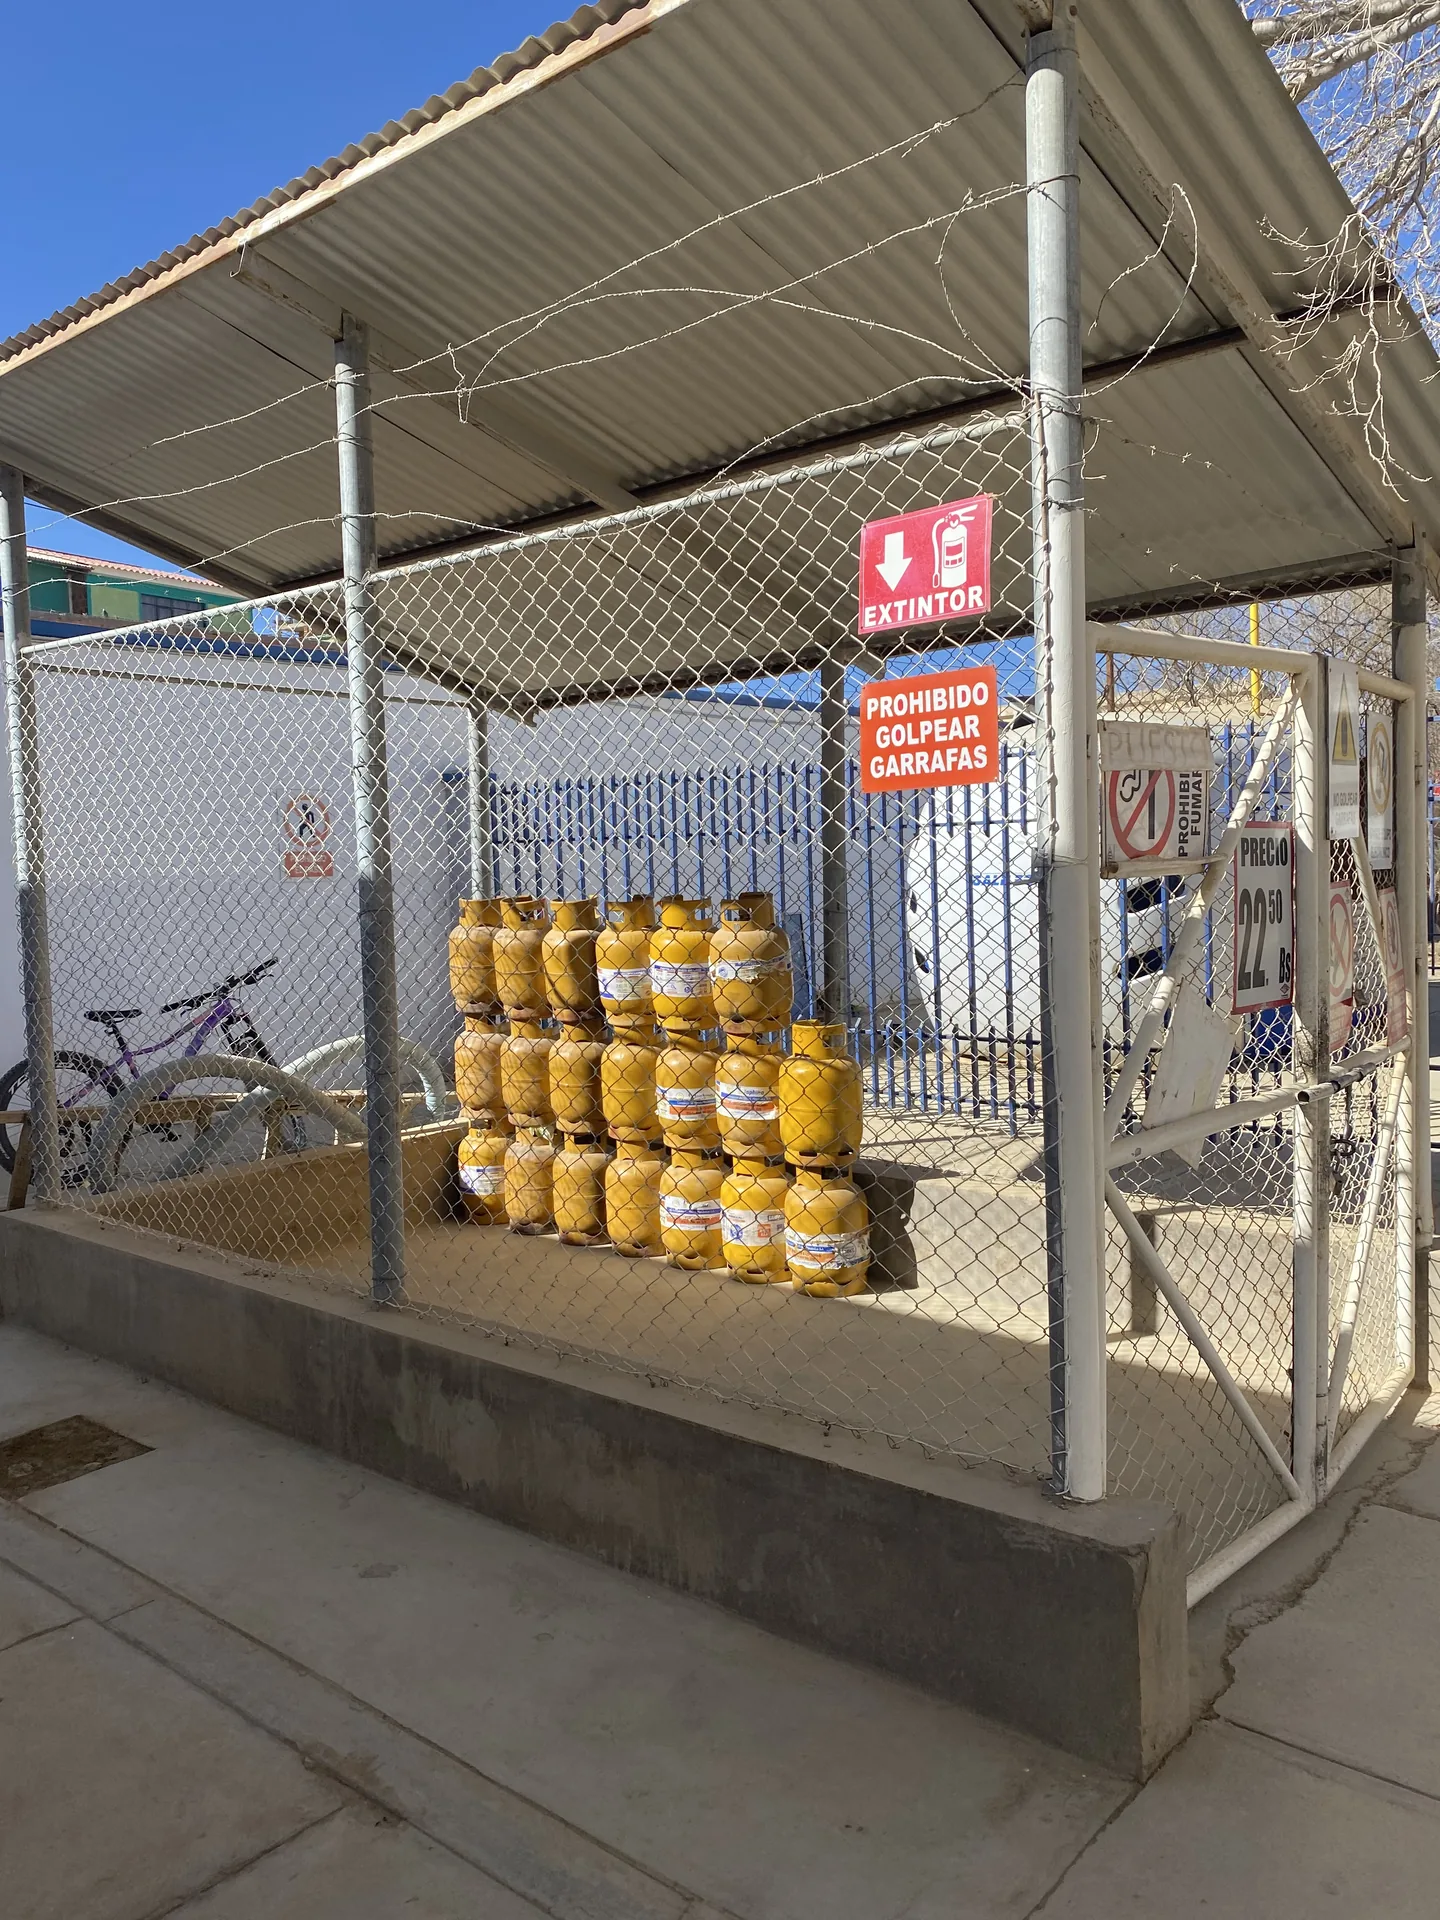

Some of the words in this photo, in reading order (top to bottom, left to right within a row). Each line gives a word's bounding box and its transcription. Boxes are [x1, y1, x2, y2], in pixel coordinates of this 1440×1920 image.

[864, 585, 984, 627] EXTINTOR
[866, 682, 989, 720] PROHIBIDO
[875, 715, 980, 748] GOLPEAR
[869, 745, 988, 778] GARRAFAS
[1240, 837, 1288, 867] PRECIO
[1279, 947, 1291, 984] Bs
